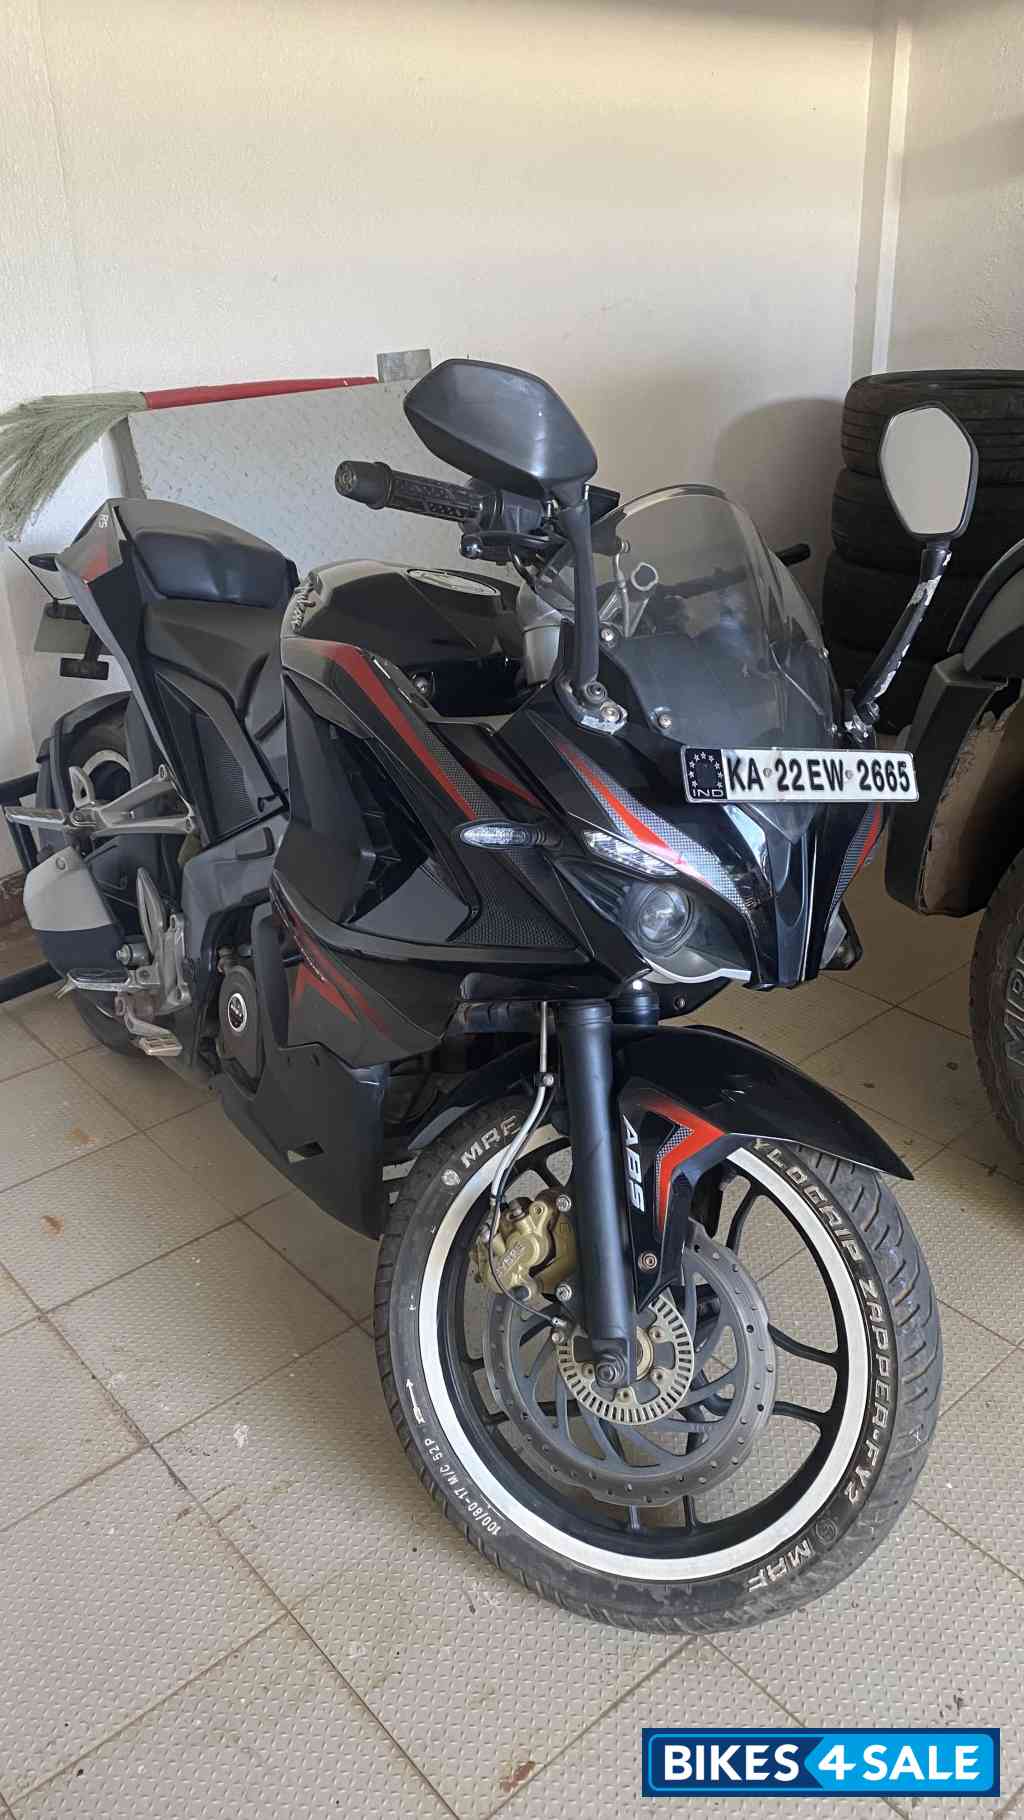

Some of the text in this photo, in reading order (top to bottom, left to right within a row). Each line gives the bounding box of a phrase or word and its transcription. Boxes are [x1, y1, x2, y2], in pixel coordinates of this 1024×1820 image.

[692, 788, 724, 798] IND
[727, 757, 765, 792] KA
[857, 758, 910, 793] 2665
[622, 1114, 645, 1213] ABS
[752, 1137, 865, 1263] YLOGRIP
[439, 1464, 459, 1486] M/C
[454, 1487, 502, 1536] 100/80-17
[744, 1538, 815, 1593] MRF
